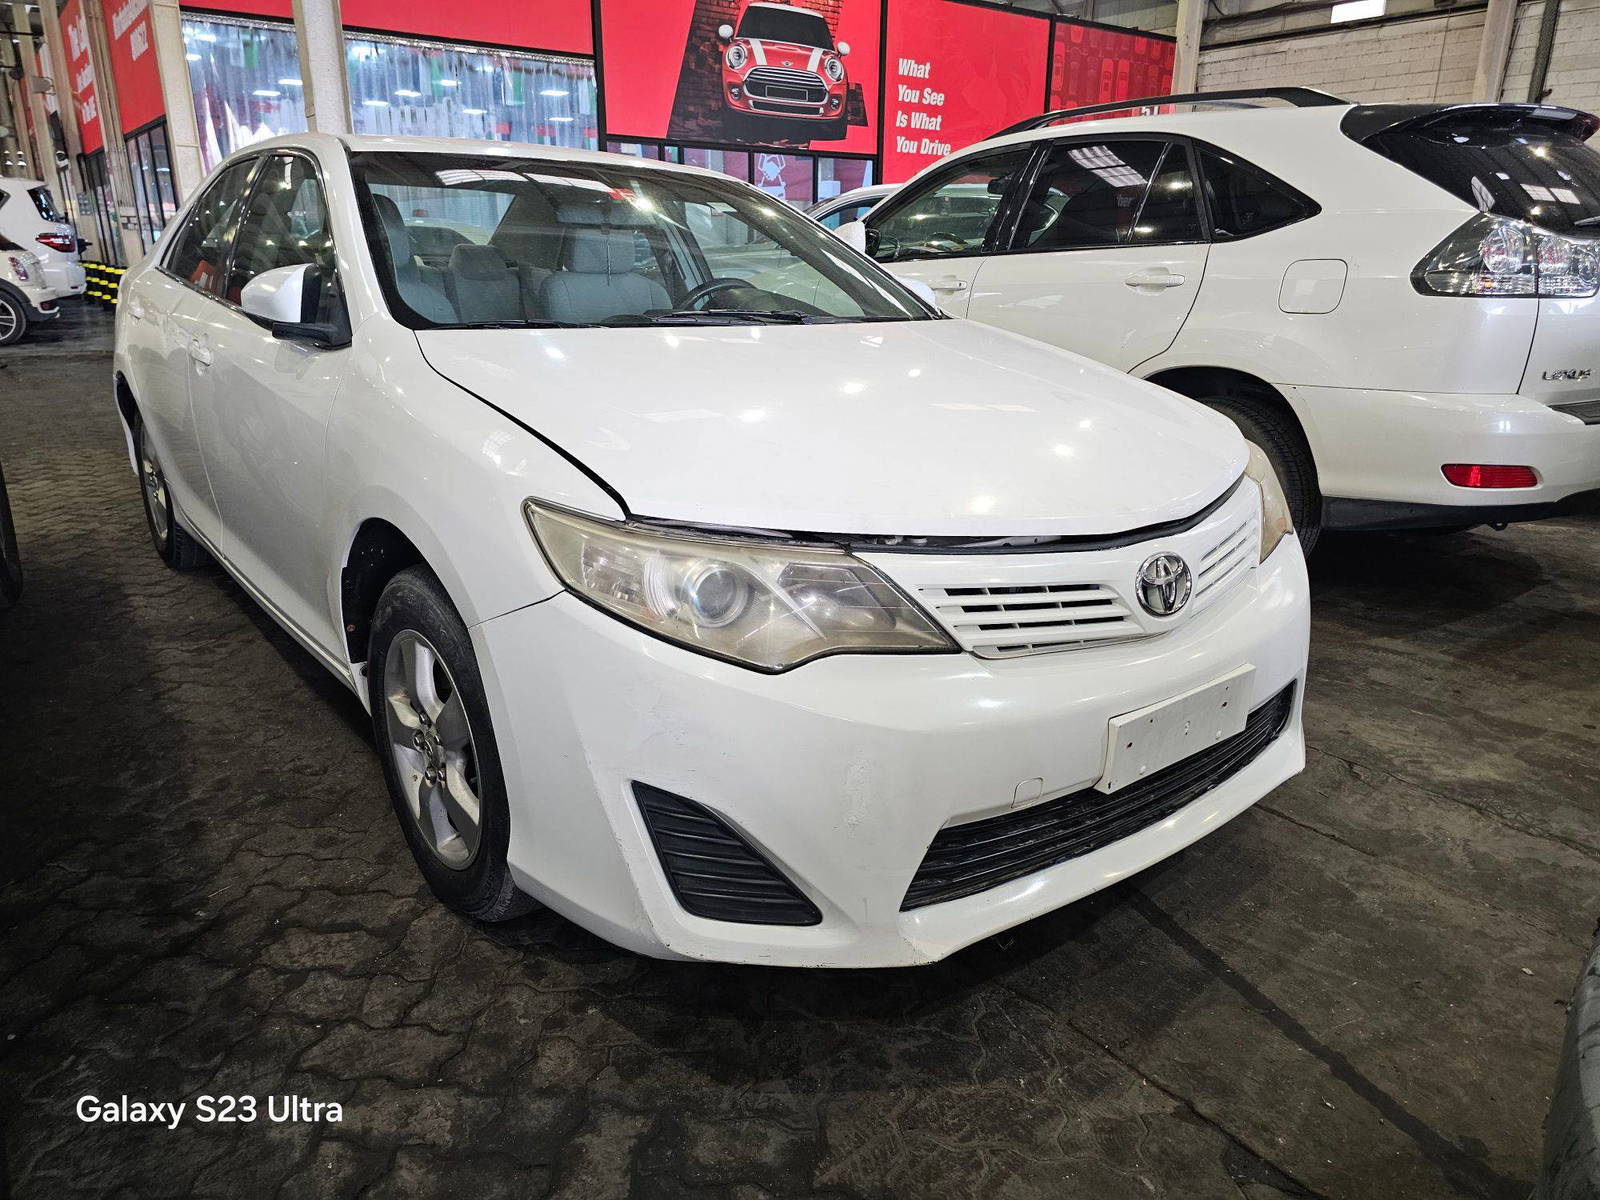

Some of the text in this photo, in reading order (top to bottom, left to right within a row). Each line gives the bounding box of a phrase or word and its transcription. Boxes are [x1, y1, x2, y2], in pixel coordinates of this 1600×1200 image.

[898, 58, 931, 79] What
[897, 84, 945, 106] You See
[895, 110, 942, 131] Is What
[896, 136, 951, 157] You Drive
